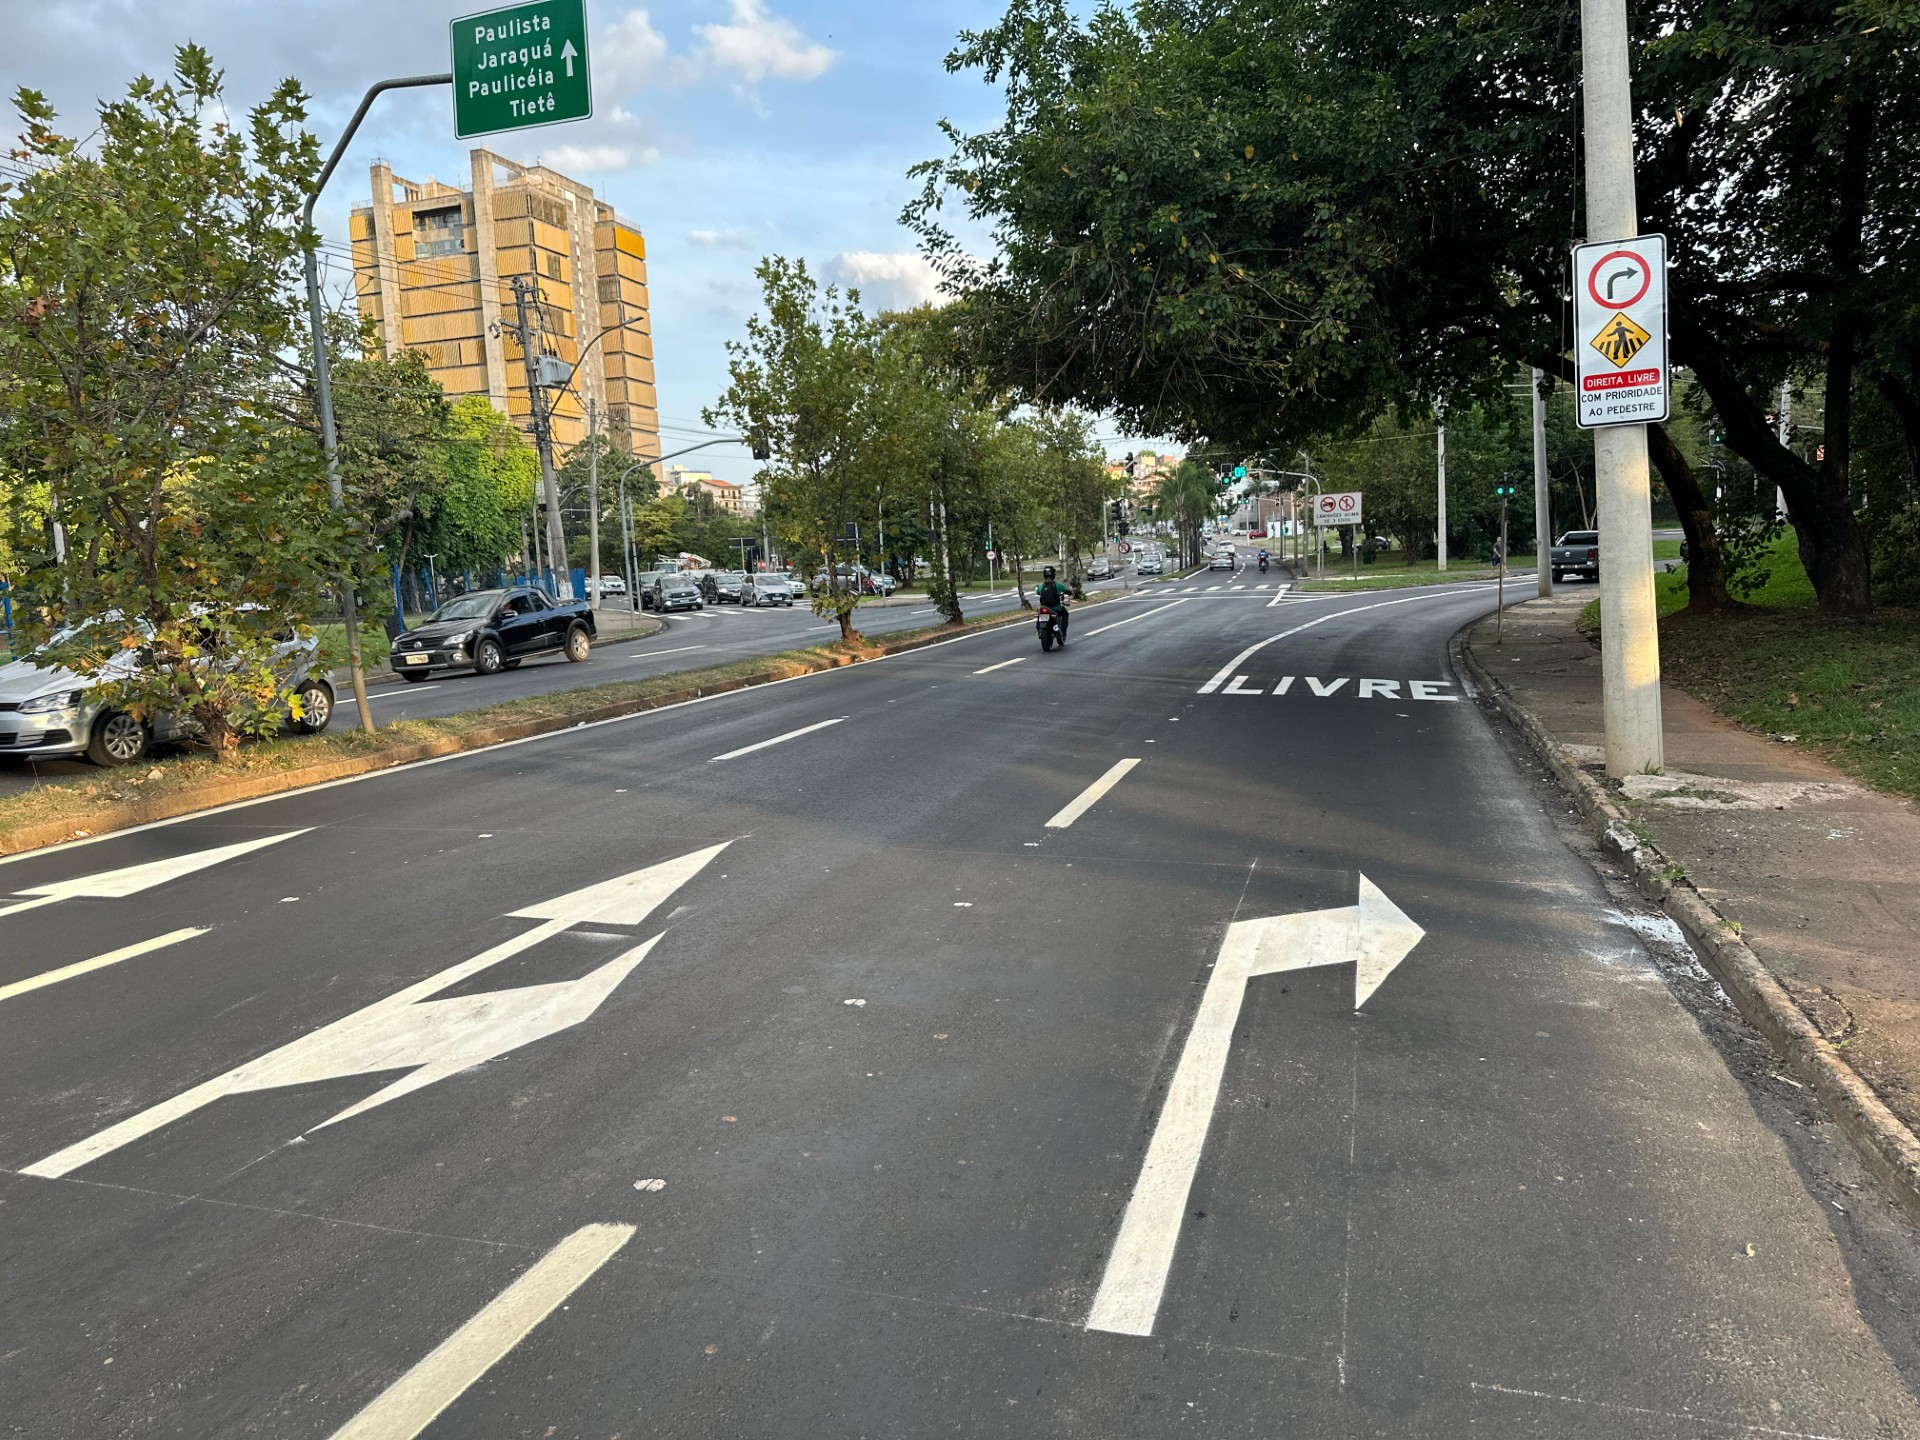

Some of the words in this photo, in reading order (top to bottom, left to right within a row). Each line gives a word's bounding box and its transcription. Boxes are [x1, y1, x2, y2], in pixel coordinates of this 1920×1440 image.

[475, 14, 551, 44] Paulista
[478, 37, 552, 69] Jaraguá
[469, 67, 554, 98] Paulicéia
[509, 91, 555, 117] Tietê
[1586, 376, 1623, 388] DIREITA
[1628, 372, 1656, 383] LIVRE
[1581, 393, 1601, 403] COM
[1605, 386, 1663, 400] PRIORIDADE
[1589, 408, 1603, 417] AO
[1607, 402, 1656, 415] PEDESTRE
[1221, 675, 1459, 702] LIVRE
